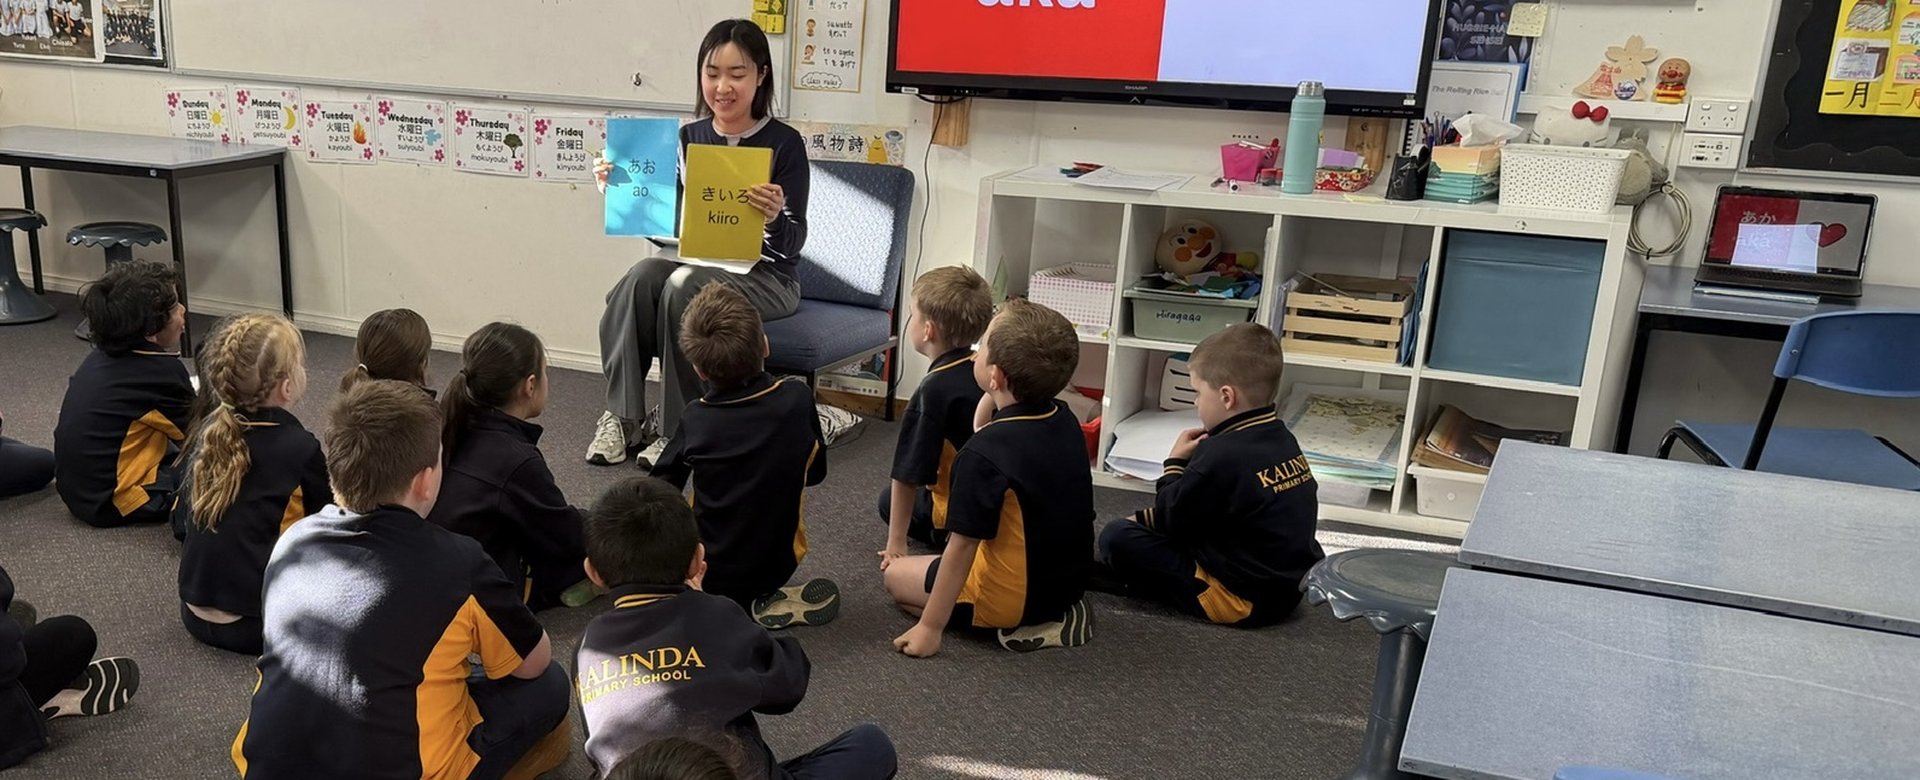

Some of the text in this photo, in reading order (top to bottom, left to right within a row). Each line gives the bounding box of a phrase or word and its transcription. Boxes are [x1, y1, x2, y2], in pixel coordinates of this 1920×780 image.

[1432, 85, 1445, 93] The
[1446, 86, 1473, 96] Rolling
[1473, 87, 1490, 95] Rice
[1824, 81, 1870, 110] 一月
[182, 100, 209, 110] Sunday
[251, 99, 282, 110] Monday
[186, 110, 208, 120] 日曜日
[256, 110, 279, 120] 月曜日
[321, 111, 354, 122] Tuesday
[387, 113, 433, 127] Wednesday
[326, 122, 350, 132] 火曜日
[398, 124, 422, 135] 水曜日
[470, 118, 510, 132] Thursday
[476, 131, 502, 142] 木曜日
[556, 127, 583, 139] Friday
[556, 139, 583, 150] 金曜日
[471, 154, 508, 163] mokuyoubi
[627, 158, 656, 175] あお
[632, 186, 649, 197] ao
[701, 186, 749, 204] きいろ
[708, 210, 739, 225] kiiro
[1740, 210, 1776, 224] あか
[1738, 233, 1770, 248] aka
[582, 669, 692, 704] RIMARY SCHOOL
